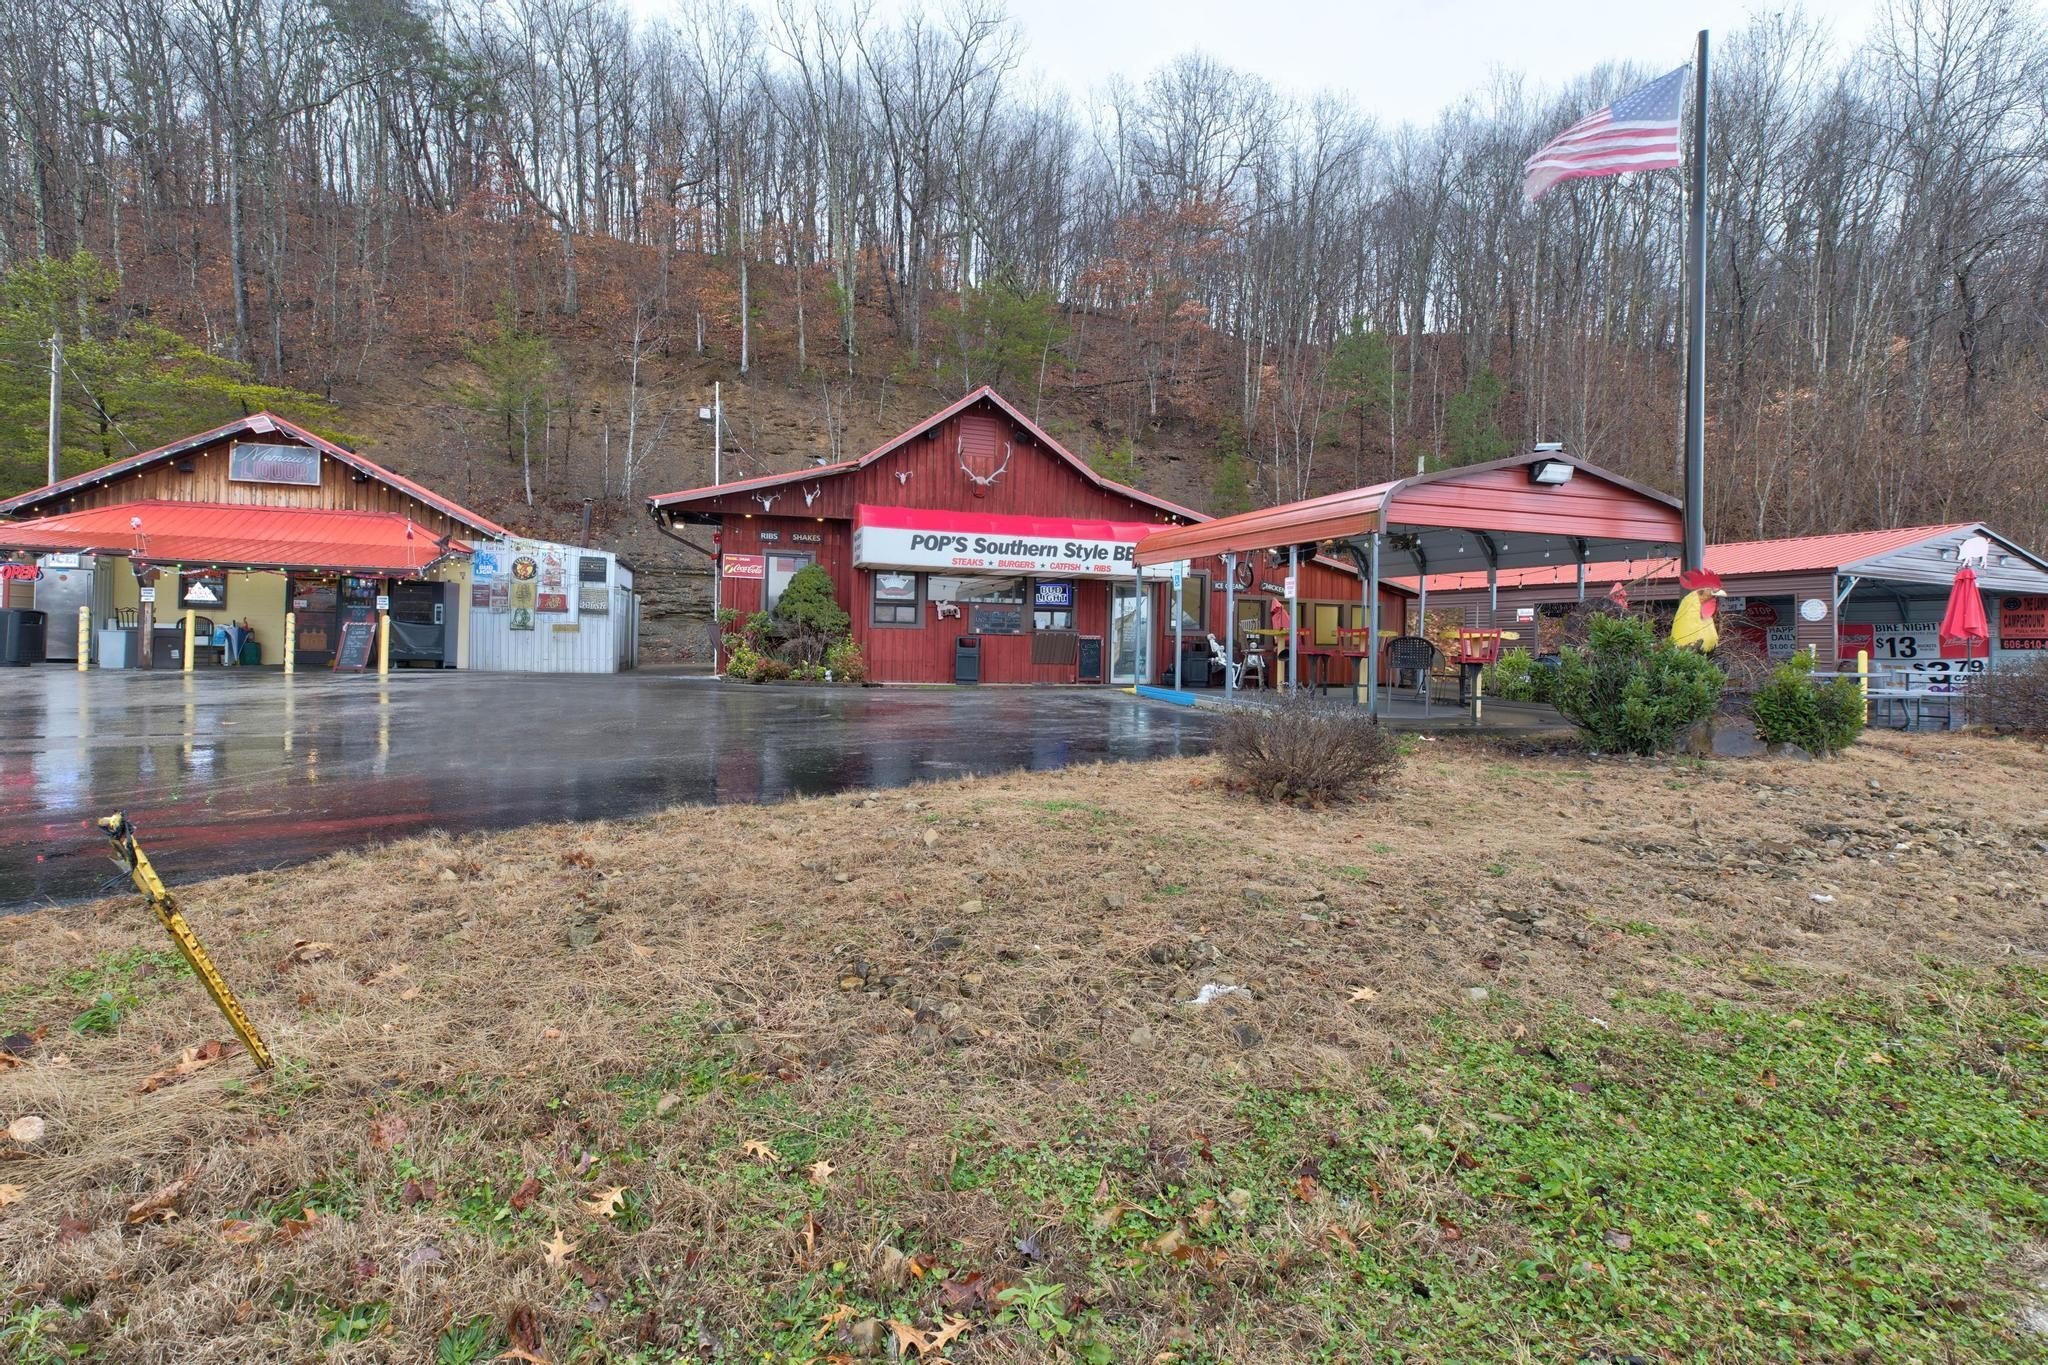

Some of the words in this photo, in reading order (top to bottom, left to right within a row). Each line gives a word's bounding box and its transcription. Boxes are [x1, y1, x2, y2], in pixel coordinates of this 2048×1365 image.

[241, 460, 309, 480] LIQUOR
[760, 532, 778, 540] RIBS
[792, 533, 821, 542] SHAKES
[910, 534, 969, 554] POP'S
[973, 537, 1058, 558] Southern
[1063, 542, 1109, 562] Style
[2, 564, 38, 580] OPEN
[733, 563, 763, 574] Coca-Cola
[951, 557, 984, 567] STEAKS
[997, 559, 1035, 569] BURGERS
[1050, 563, 1081, 571] CATFISH
[1093, 565, 1112, 573] RIBS
[1040, 585, 1063, 595] BUD
[1036, 594, 1067, 602] LIGHT
[1875, 624, 1899, 632] BIKE
[1902, 622, 1937, 632] NIGHT
[2003, 614, 2045, 628] CAMPGROUND
[1876, 636, 1917, 658] $13
